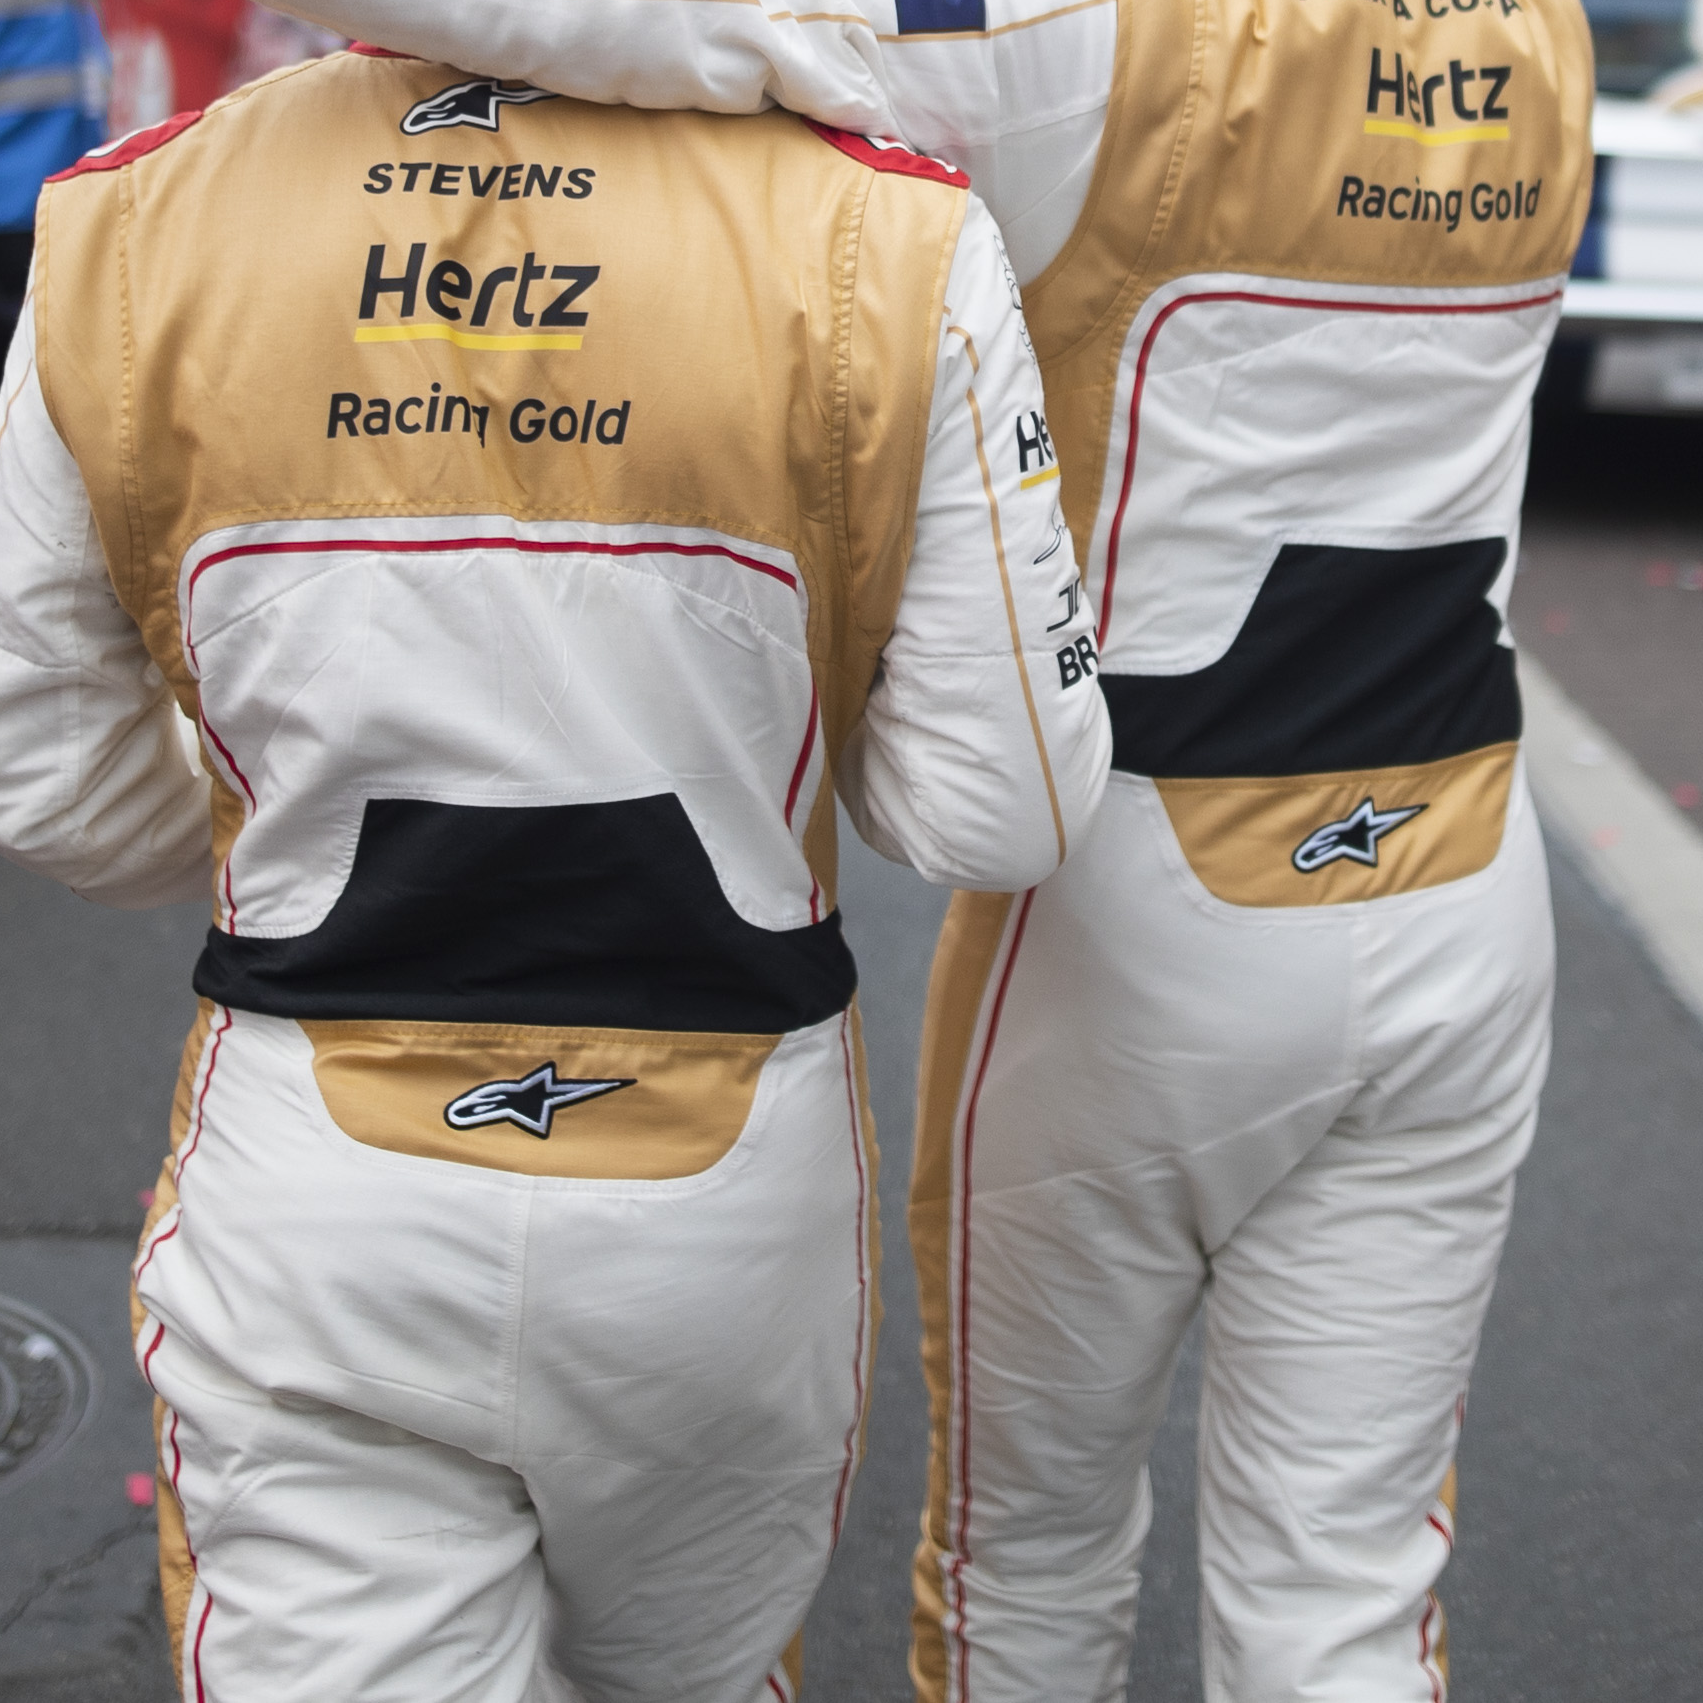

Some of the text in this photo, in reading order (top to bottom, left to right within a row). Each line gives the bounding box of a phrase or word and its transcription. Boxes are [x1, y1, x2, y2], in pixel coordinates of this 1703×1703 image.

[1366, 47, 1512, 128] Hertz
[363, 162, 597, 200] STEVENS
[1336, 174, 1543, 234] Racing Gold
[358, 242, 601, 328] Hertz
[327, 382, 632, 449] Racing Gold
